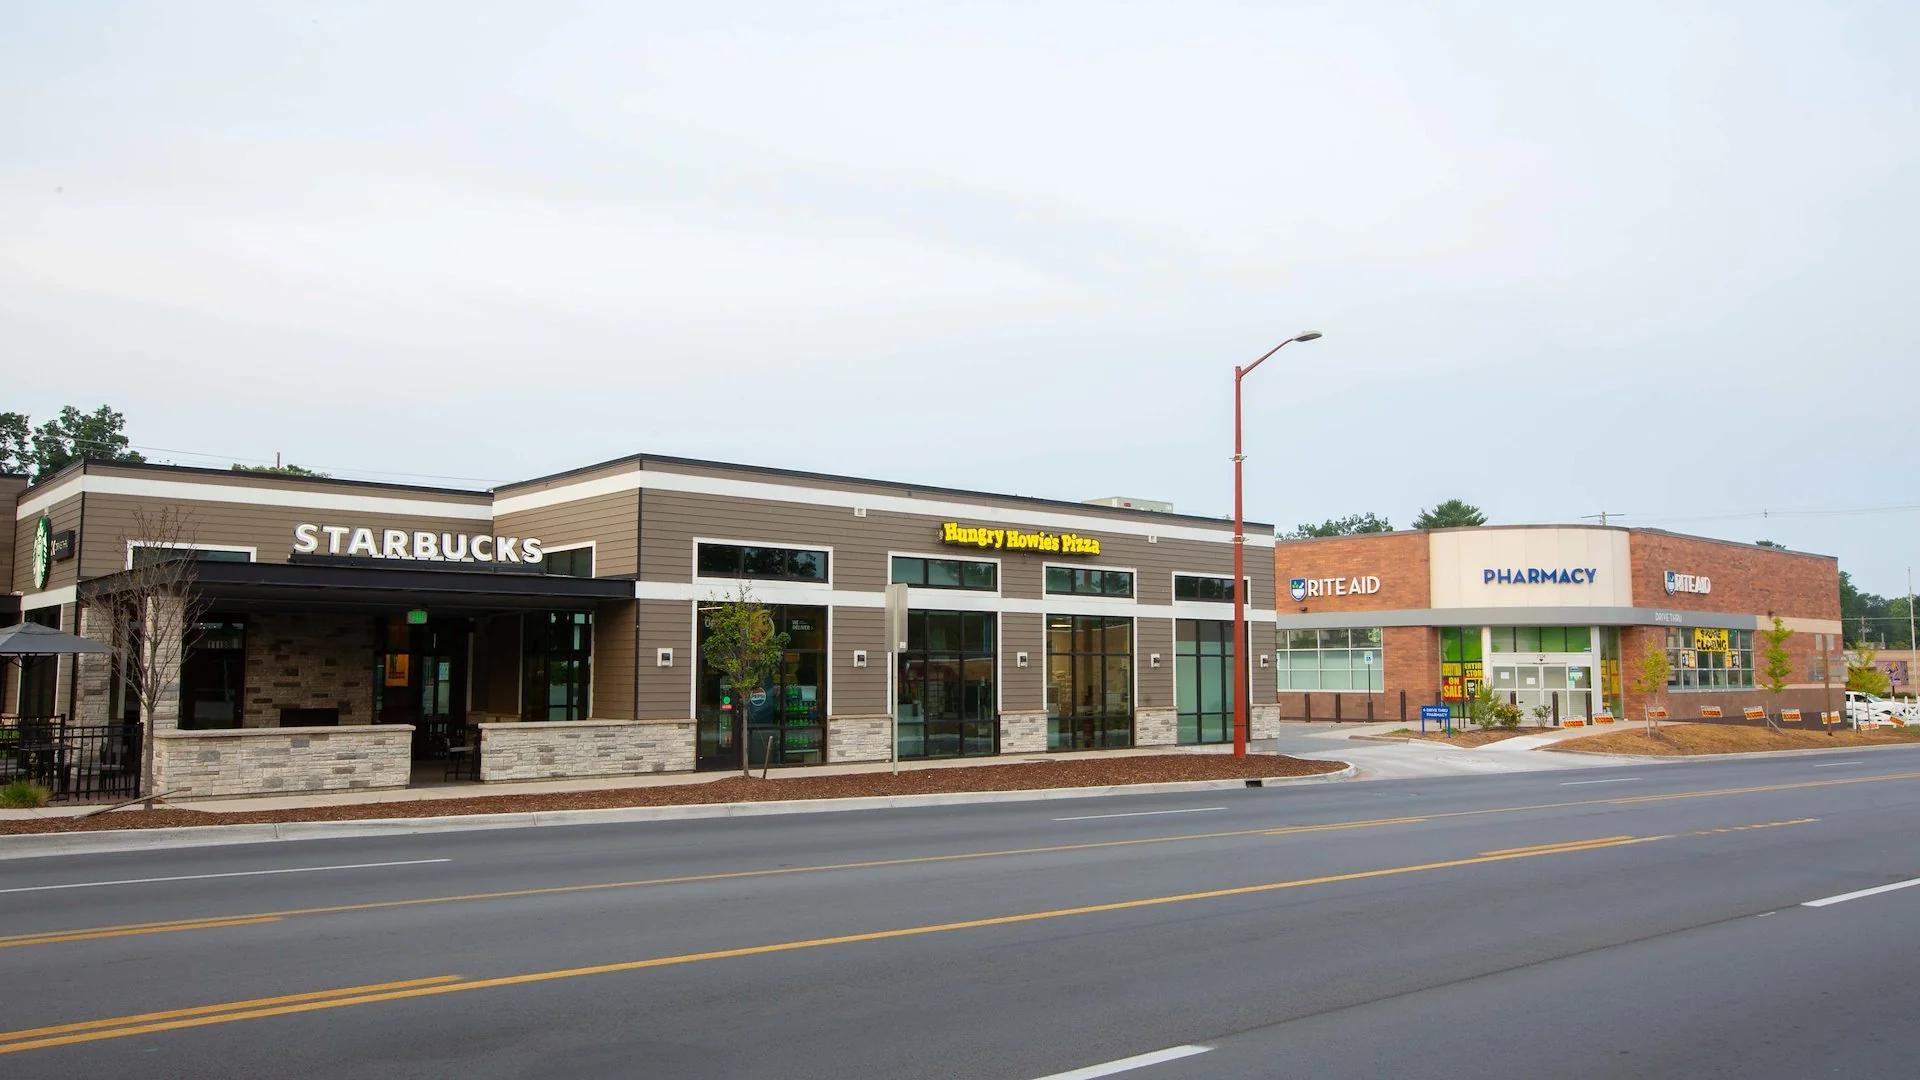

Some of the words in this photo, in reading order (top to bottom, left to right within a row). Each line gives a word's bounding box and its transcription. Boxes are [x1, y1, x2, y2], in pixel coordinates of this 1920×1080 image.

[293, 523, 544, 564] STARBUCKS
[944, 522, 1004, 548] Hungry
[1006, 531, 1060, 551] Howie's
[1061, 534, 1100, 555] Pizza
[1483, 568, 1597, 585] PHARMACY
[1674, 573, 1695, 593] RITE
[1695, 575, 1712, 594] AID
[1307, 577, 1347, 597] RITE
[1348, 575, 1381, 595] AID
[1655, 612, 1669, 622] DRIVE
[1670, 613, 1682, 623] THRU
[1700, 629, 1721, 639] STORE
[1696, 639, 1727, 651] CLOSING
[1448, 677, 1460, 685] ON
[1443, 685, 1463, 698] SALE
